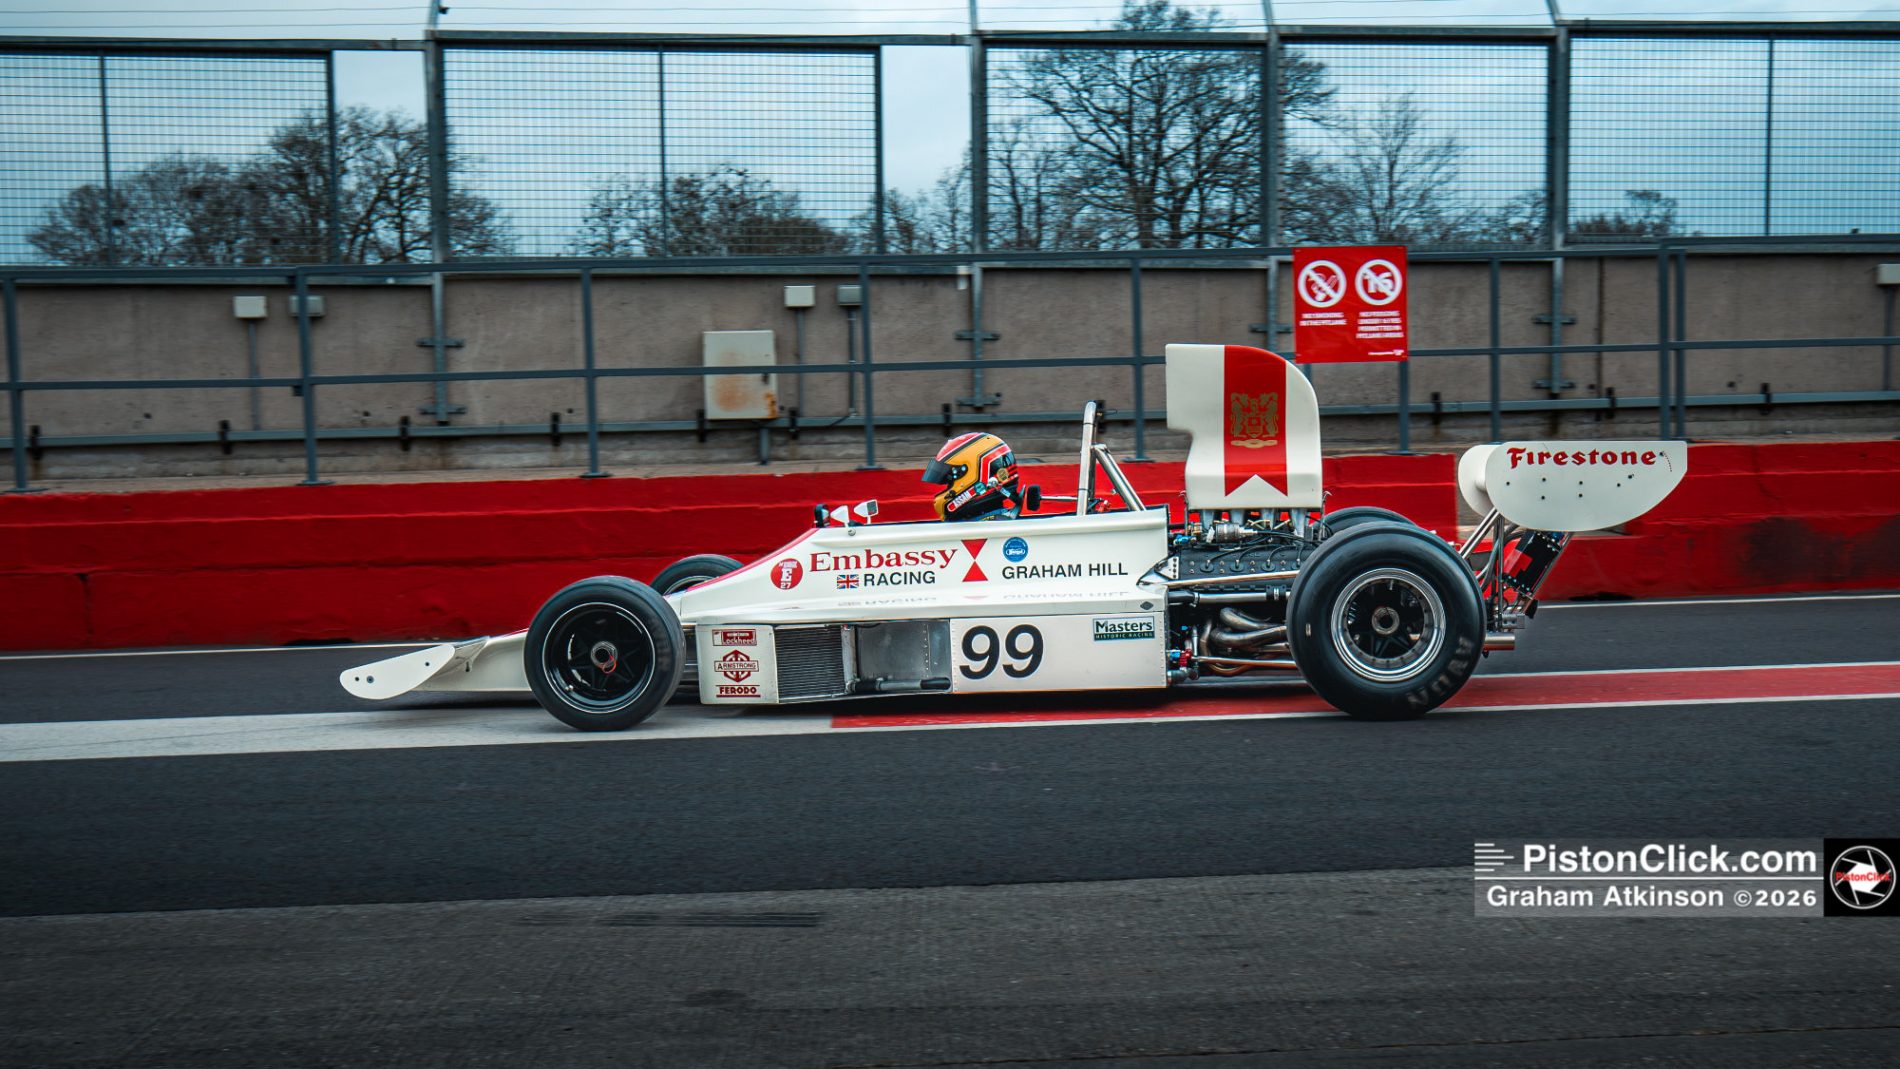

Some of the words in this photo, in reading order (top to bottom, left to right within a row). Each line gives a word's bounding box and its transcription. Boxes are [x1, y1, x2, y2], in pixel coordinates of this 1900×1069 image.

[1507, 448, 1657, 470] Firestone
[809, 549, 958, 572] Embassy
[781, 568, 792, 581] E
[863, 571, 936, 587] RACING
[1002, 564, 1082, 580] GRAHAM
[1088, 562, 1128, 576] HILL
[1095, 620, 1153, 633] Masters
[959, 624, 1044, 680] 99
[717, 662, 757, 671] ARMSTRONG
[719, 686, 757, 695] FERODO
